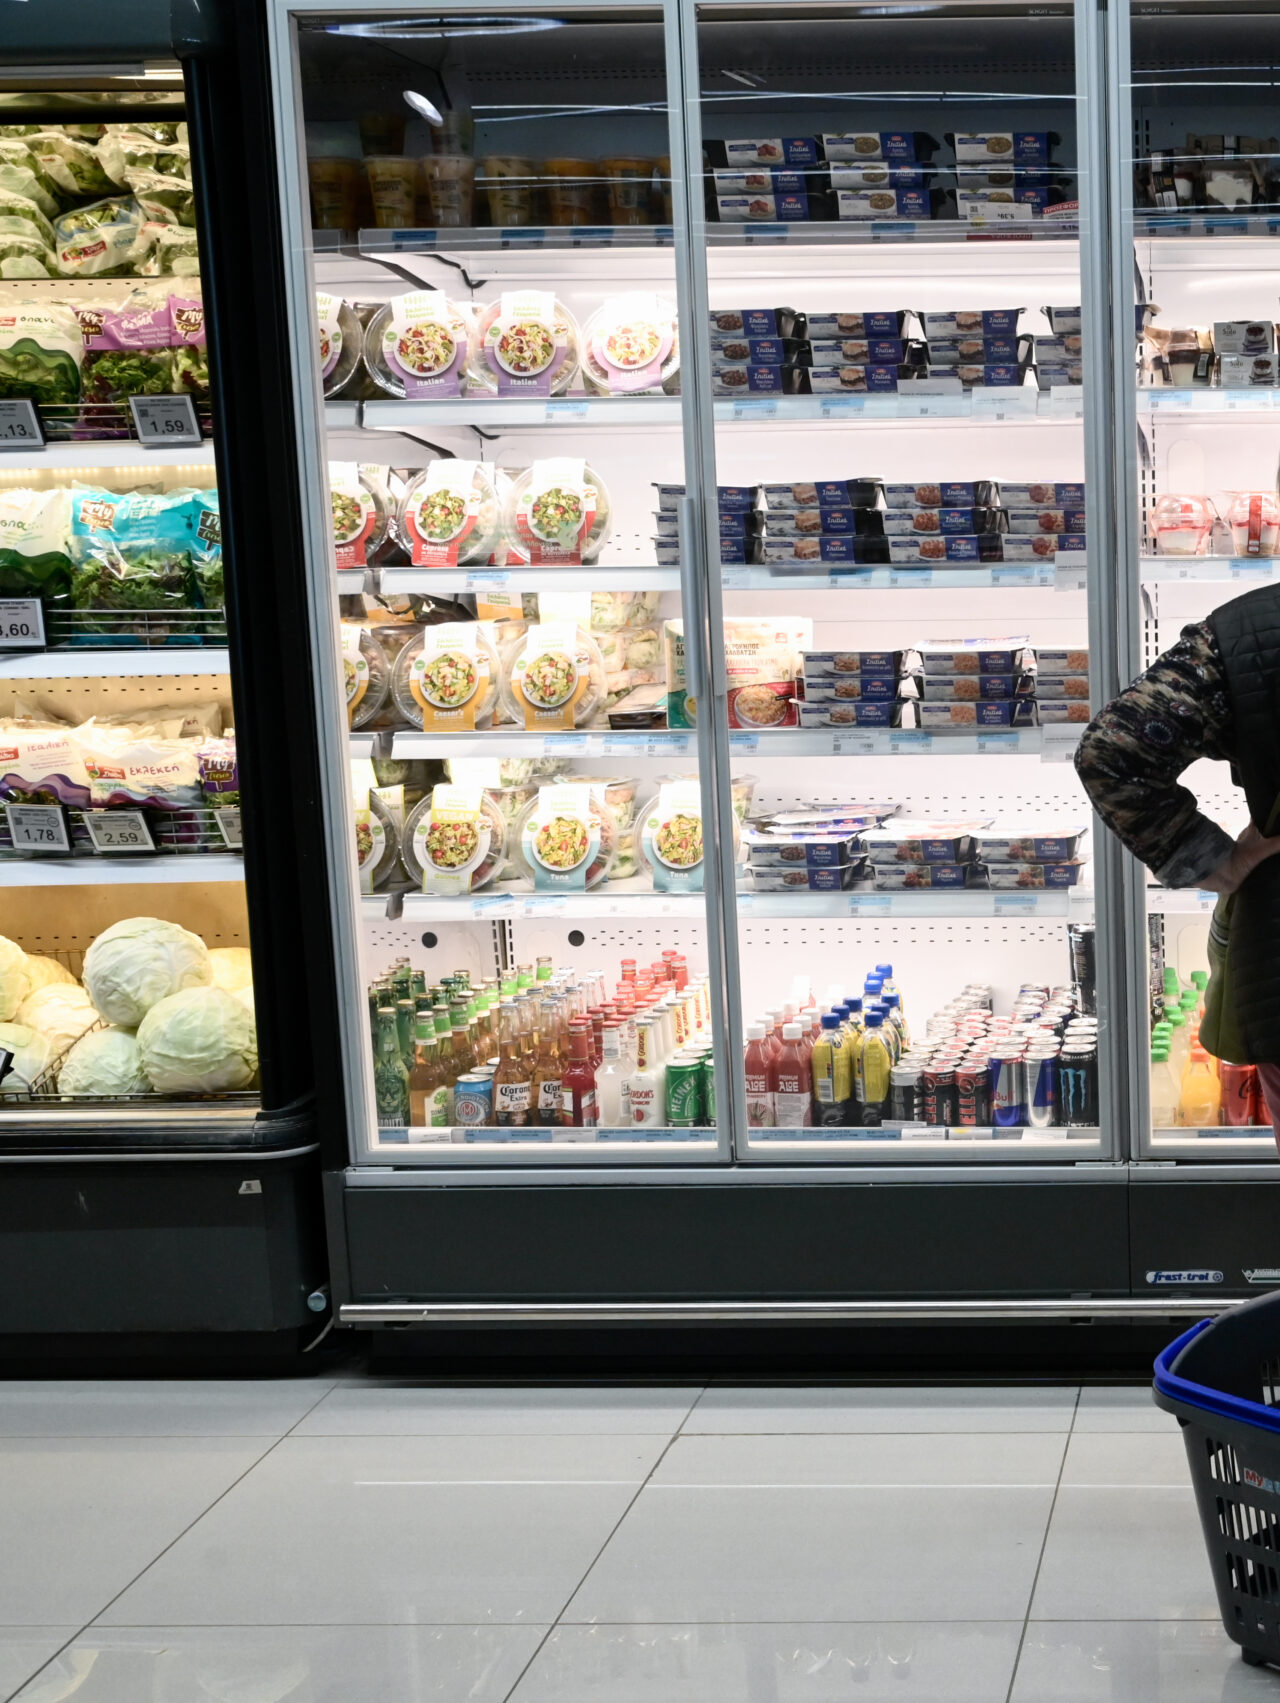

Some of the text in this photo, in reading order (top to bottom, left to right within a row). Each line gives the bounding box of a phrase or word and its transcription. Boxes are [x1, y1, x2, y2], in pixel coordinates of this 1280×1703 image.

[416, 378, 445, 387] Italian
[510, 378, 538, 386] Italian
[0, 424, 27, 439] ,13
[150, 420, 185, 434] 1,59
[435, 809, 475, 822] VEGAN
[24, 829, 55, 841] 1,78
[104, 832, 139, 843] 2,59
[669, 871, 689, 879] Tuna
[543, 1083, 562, 1094] Cor
[778, 1081, 799, 1092] ALOE
[630, 1089, 655, 1099] ORDON'S
[671, 1075, 697, 1112] HEINEK
[925, 1095, 937, 1124] ELL
[960, 1095, 976, 1125] ELL
[1153, 1271, 1209, 1283] frost-trol
